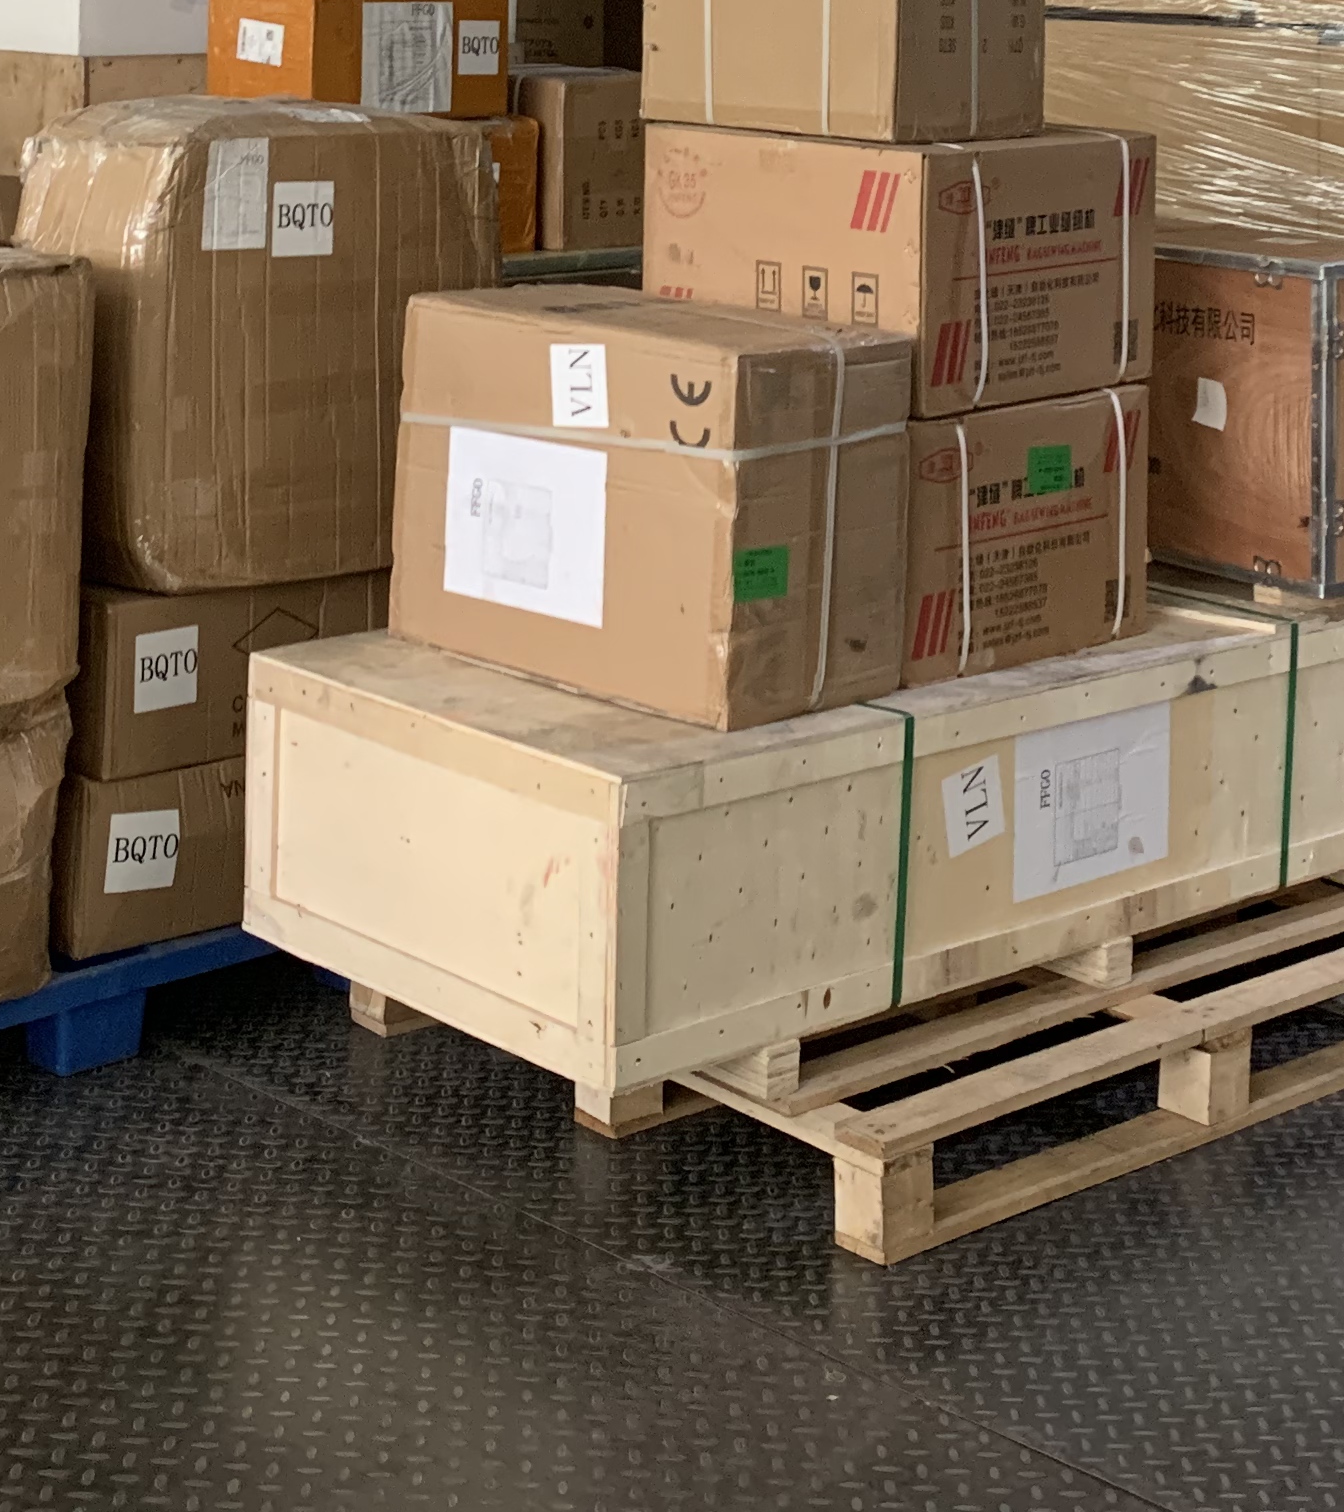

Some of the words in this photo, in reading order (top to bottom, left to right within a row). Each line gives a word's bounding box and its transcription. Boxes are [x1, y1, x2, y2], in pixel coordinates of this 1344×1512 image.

[461, 35, 500, 57] BQTO
[277, 202, 334, 231] BQTO
[1155, 299, 1256, 346] 科技有限公司
[568, 347, 592, 418] VLN
[139, 648, 199, 684] BQTO
[962, 765, 991, 843] VLN
[113, 832, 180, 864] BQTO
